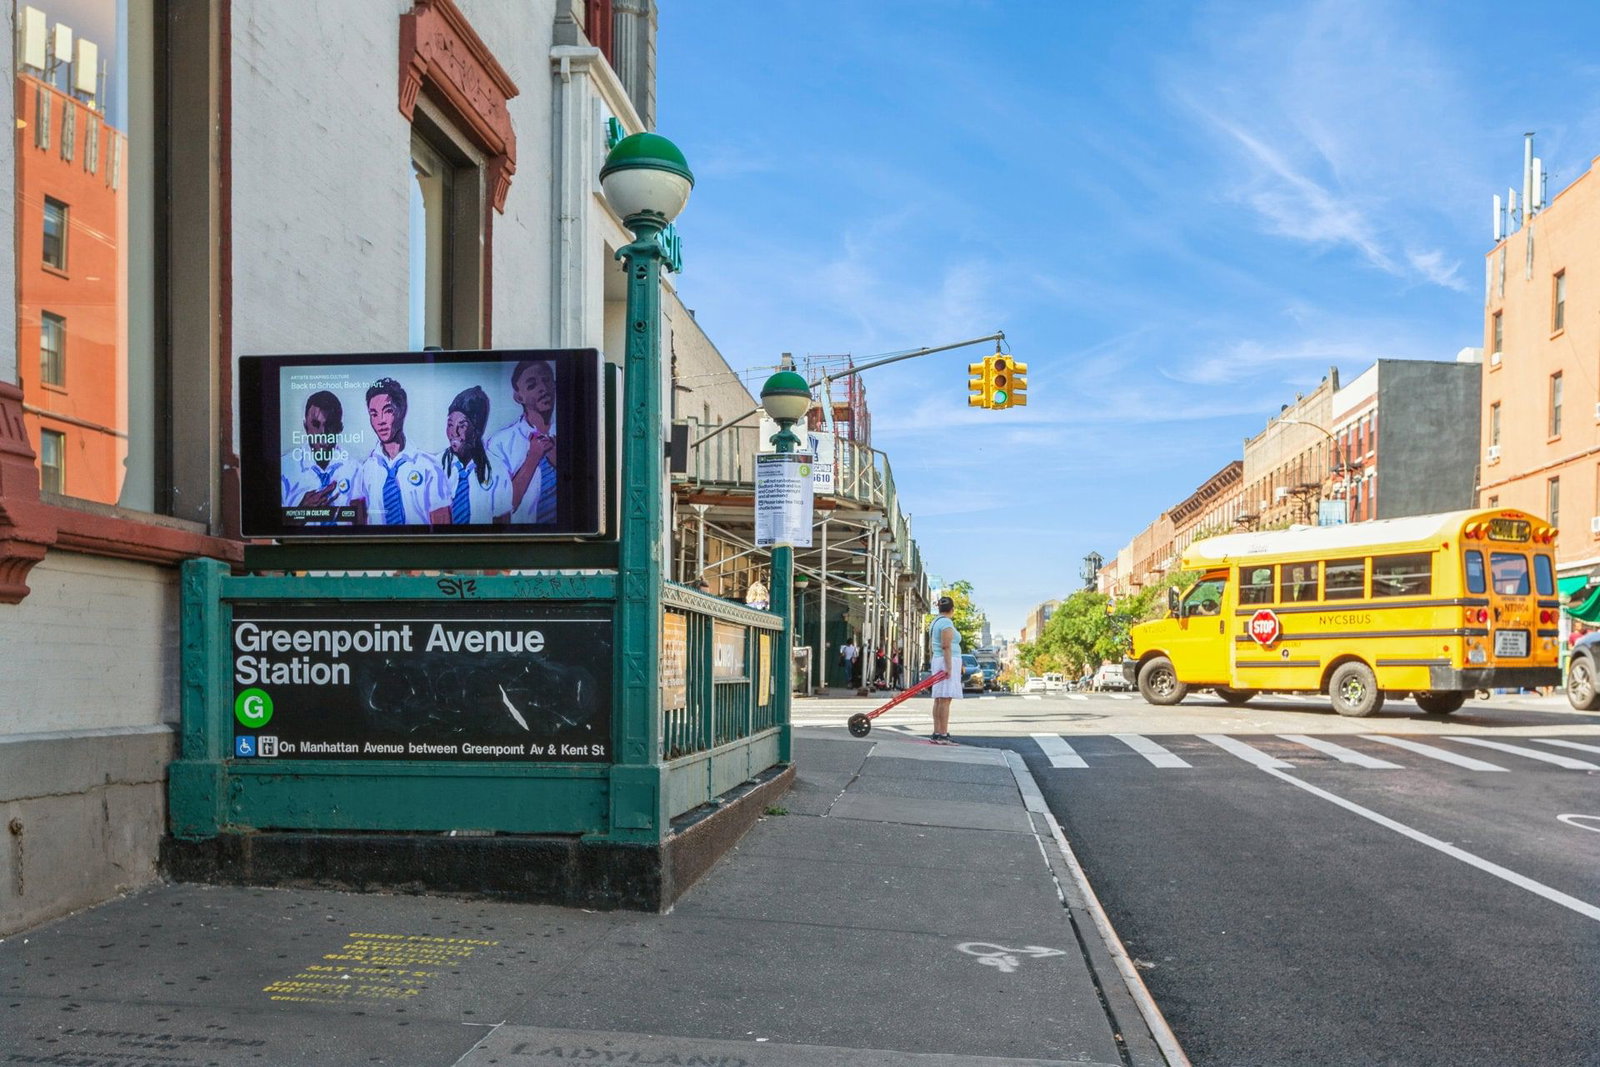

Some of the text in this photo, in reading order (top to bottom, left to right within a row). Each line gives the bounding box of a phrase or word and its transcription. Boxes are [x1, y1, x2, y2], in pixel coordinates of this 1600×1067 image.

[291, 382, 308, 390] Back
[317, 381, 343, 390] School,
[344, 381, 362, 389] Back
[363, 381, 370, 389] to
[292, 430, 364, 444] Emmanuel
[292, 447, 349, 461] Chidube
[1253, 619, 1275, 634] STOP
[1319, 614, 1371, 625] NYCSBUS
[235, 622, 545, 657] Greenpoint Avenue
[235, 655, 350, 685] Station
[243, 695, 264, 719] G
[279, 741, 605, 757] On Manhattan Avenue between Greenpoint Av & Kent St
